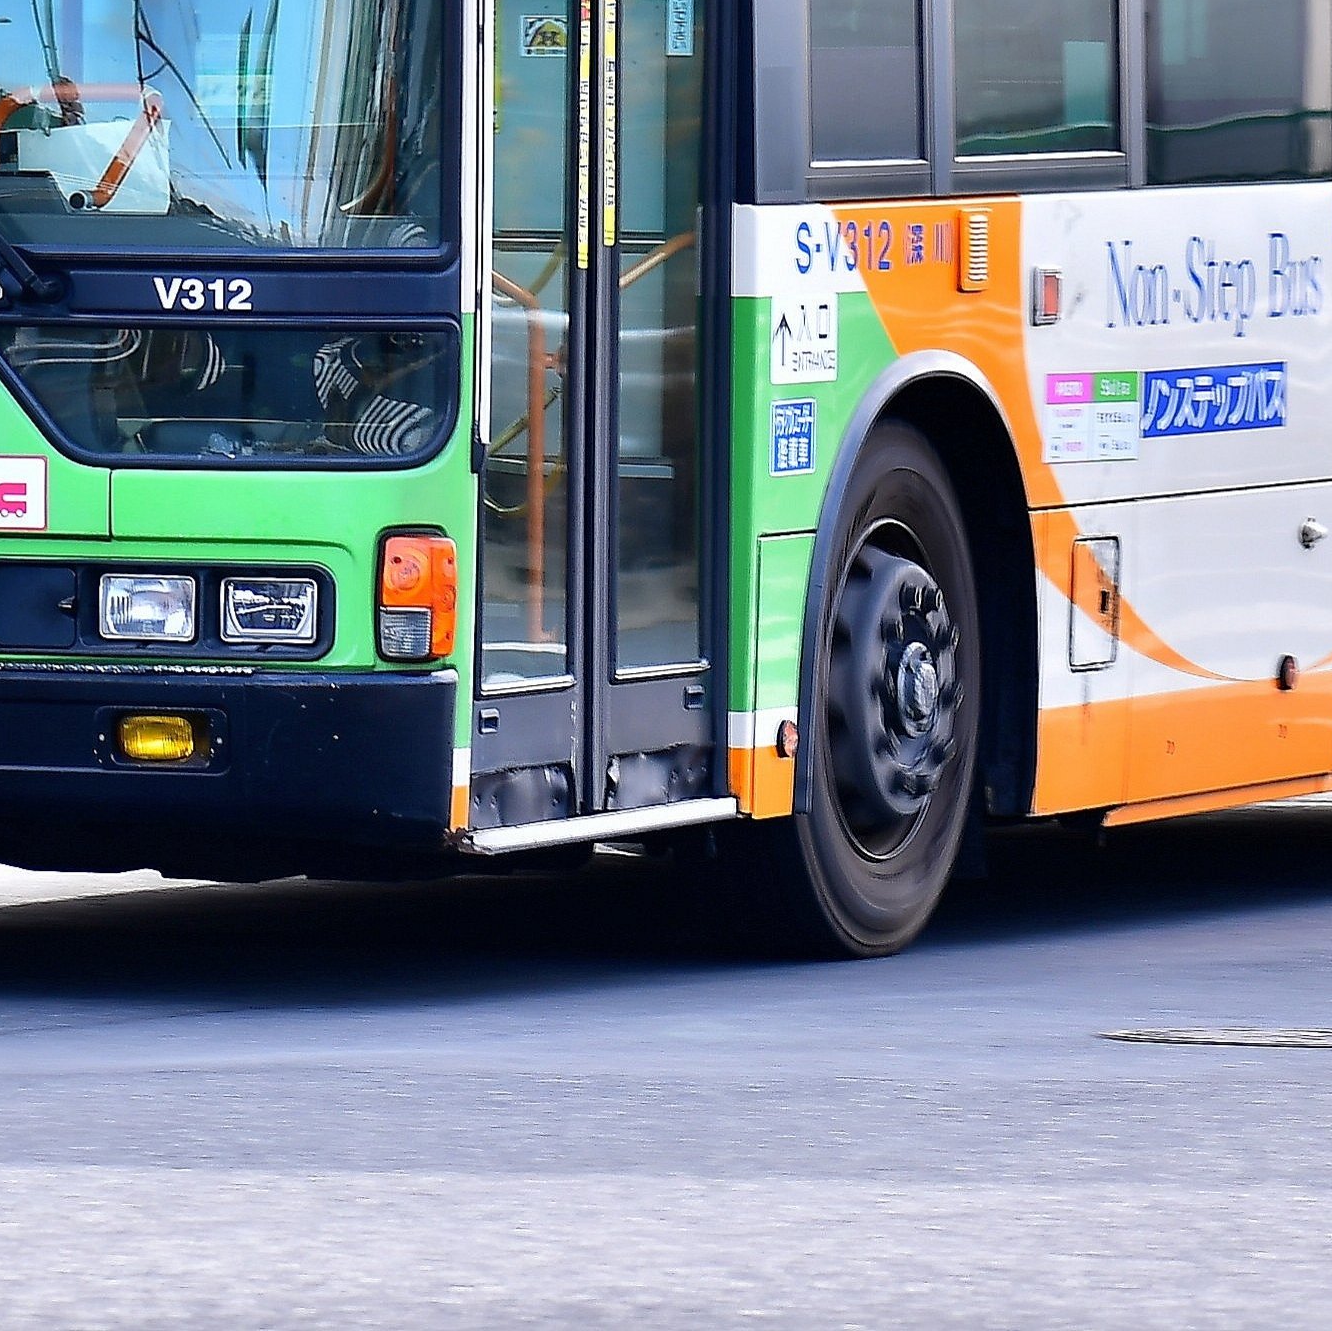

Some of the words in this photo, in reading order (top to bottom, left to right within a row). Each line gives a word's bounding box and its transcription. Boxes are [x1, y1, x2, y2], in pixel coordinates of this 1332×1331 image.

[795, 220, 894, 275] S-V312
[1267, 231, 1324, 318] Bus
[152, 276, 253, 311] V312
[796, 304, 831, 342] 入口
[1139, 369, 1287, 432] ノンステップバス
